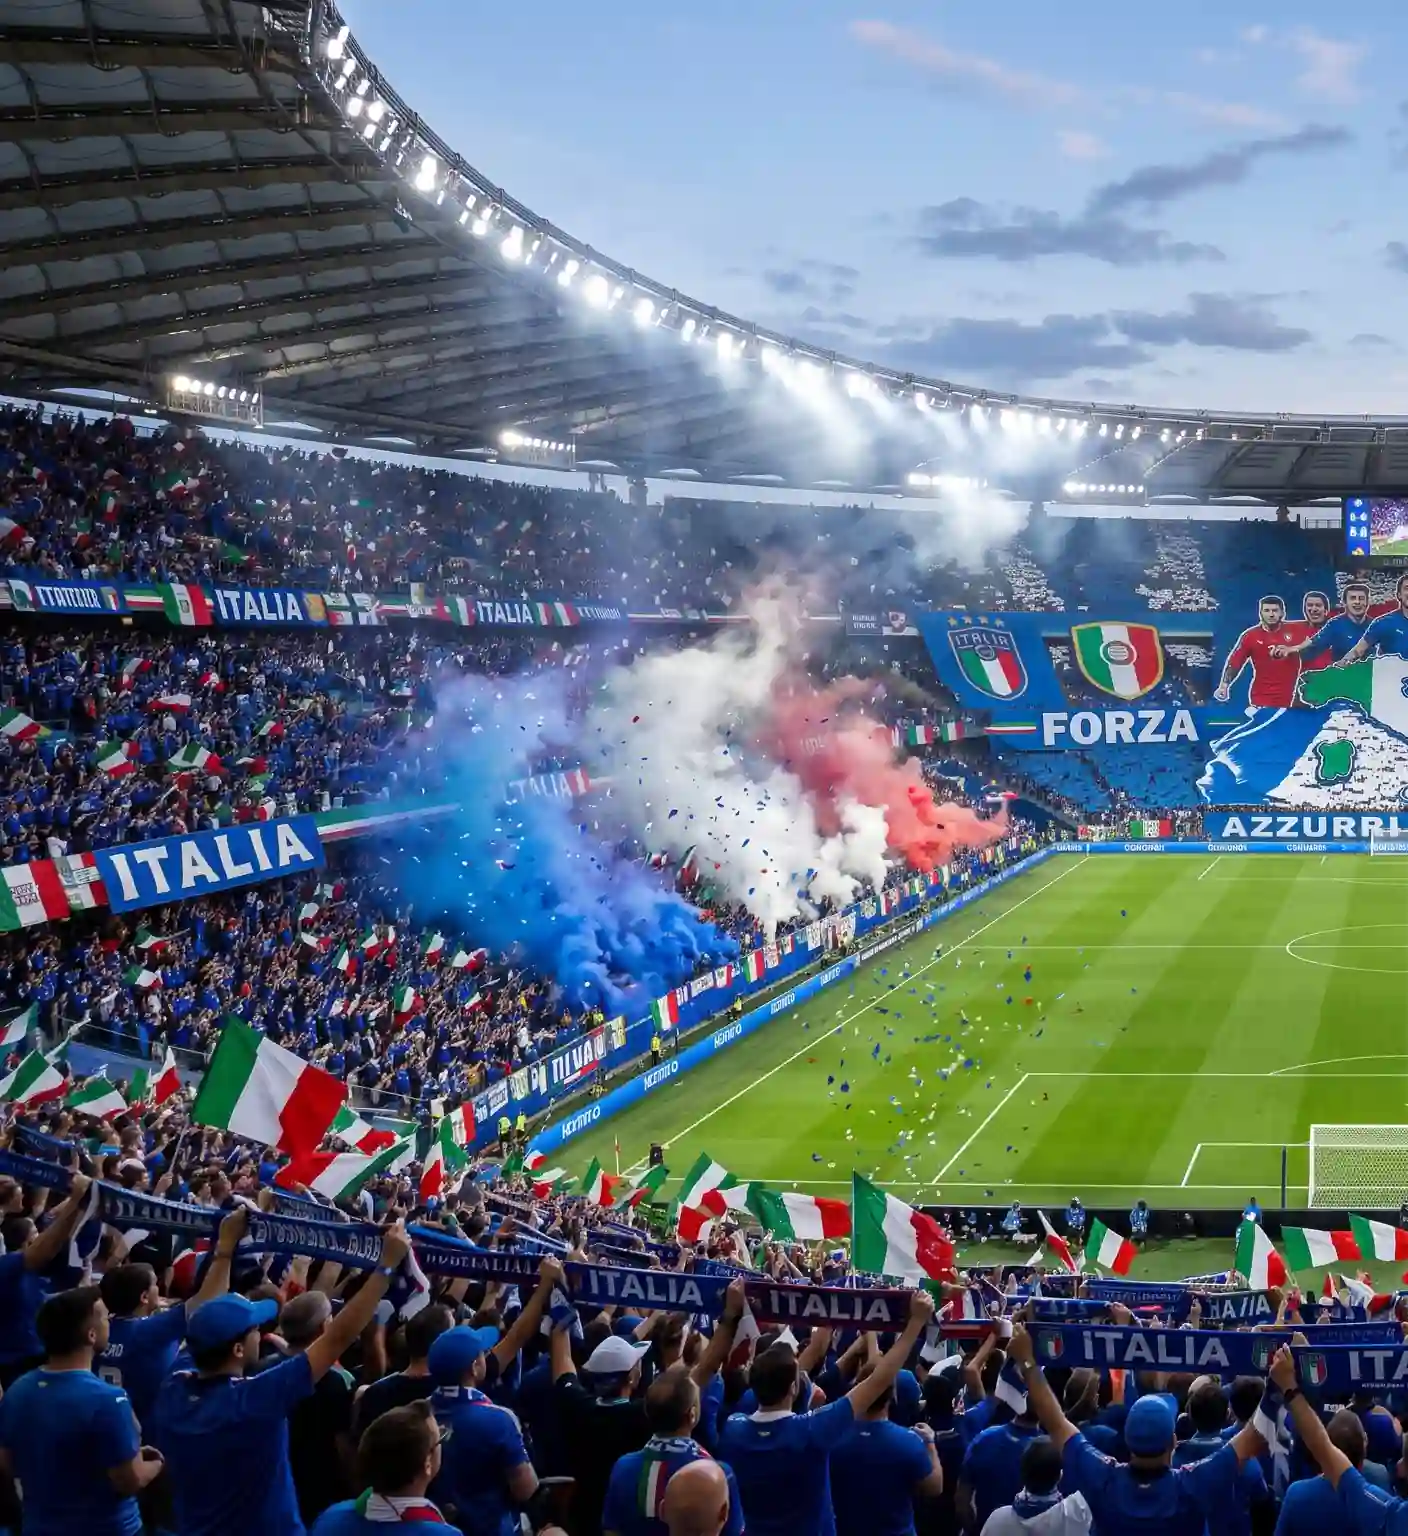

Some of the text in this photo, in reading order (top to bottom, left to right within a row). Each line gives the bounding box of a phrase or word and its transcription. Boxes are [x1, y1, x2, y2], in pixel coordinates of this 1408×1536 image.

[214, 589, 304, 621] ITALIA
[477, 601, 534, 624] ITALIA
[1042, 709, 1200, 746] FORZA
[1221, 816, 1400, 838] AZZURRI
[109, 823, 315, 901] ITALIA
[590, 1268, 704, 1306] ITALIA
[769, 1289, 892, 1322] ITALIA
[1083, 1330, 1230, 1368] ITALIA
